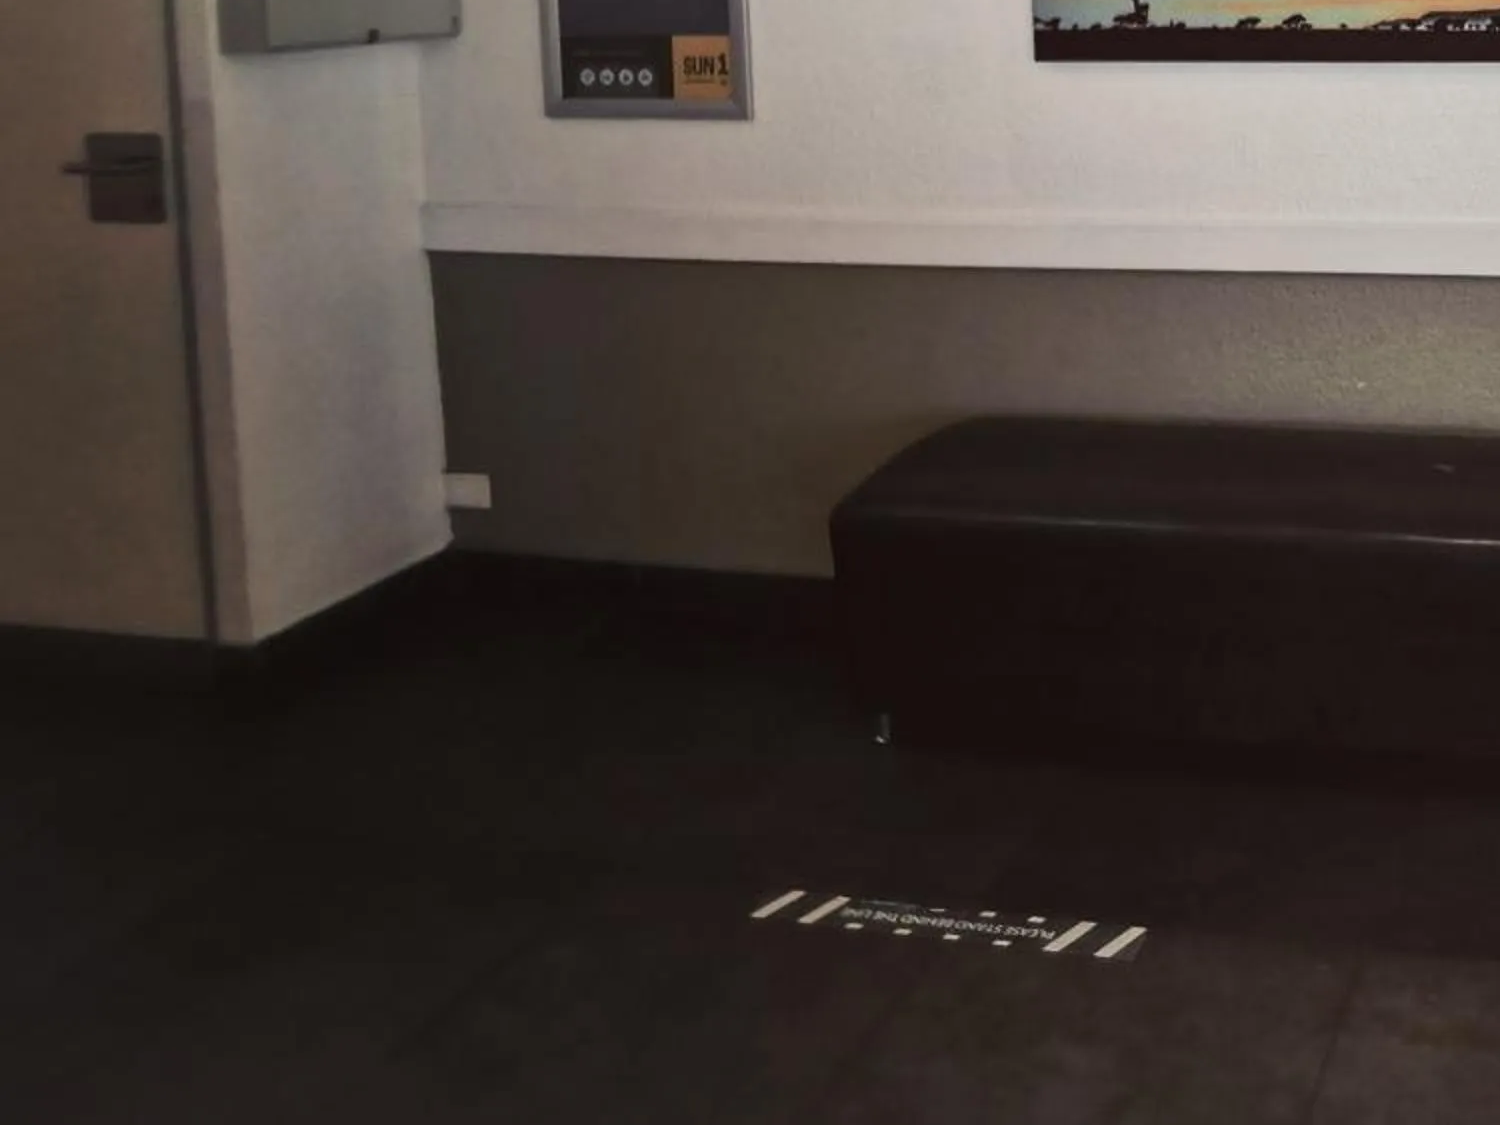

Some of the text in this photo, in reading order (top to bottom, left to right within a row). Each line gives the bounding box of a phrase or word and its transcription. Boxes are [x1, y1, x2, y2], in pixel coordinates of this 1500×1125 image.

[900, 914, 955, 929] BEHIND
[955, 920, 1004, 934] STAND
[1004, 926, 1056, 940] PLEASE
